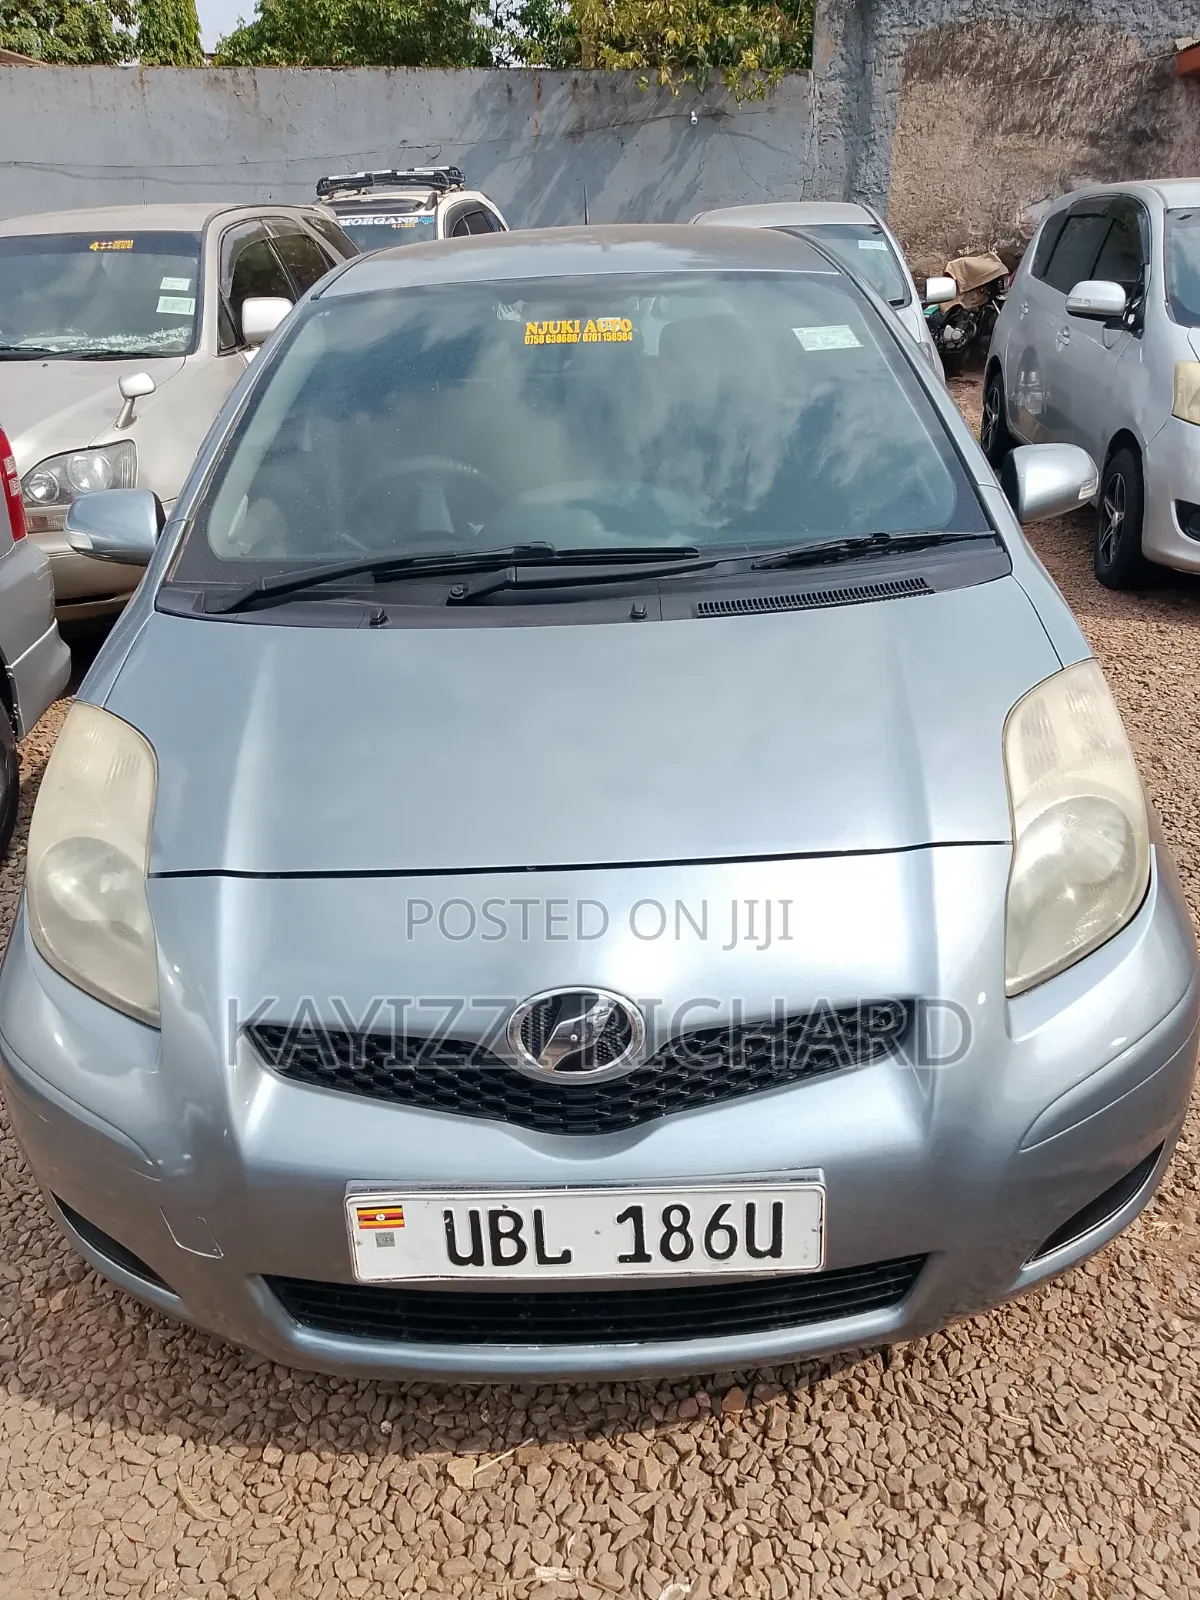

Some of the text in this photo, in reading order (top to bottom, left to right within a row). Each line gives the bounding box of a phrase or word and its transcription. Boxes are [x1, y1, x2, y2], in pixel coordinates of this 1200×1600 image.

[525, 319, 632, 335] NJUKI AUTO
[443, 1200, 784, 1267] UBL 186U
